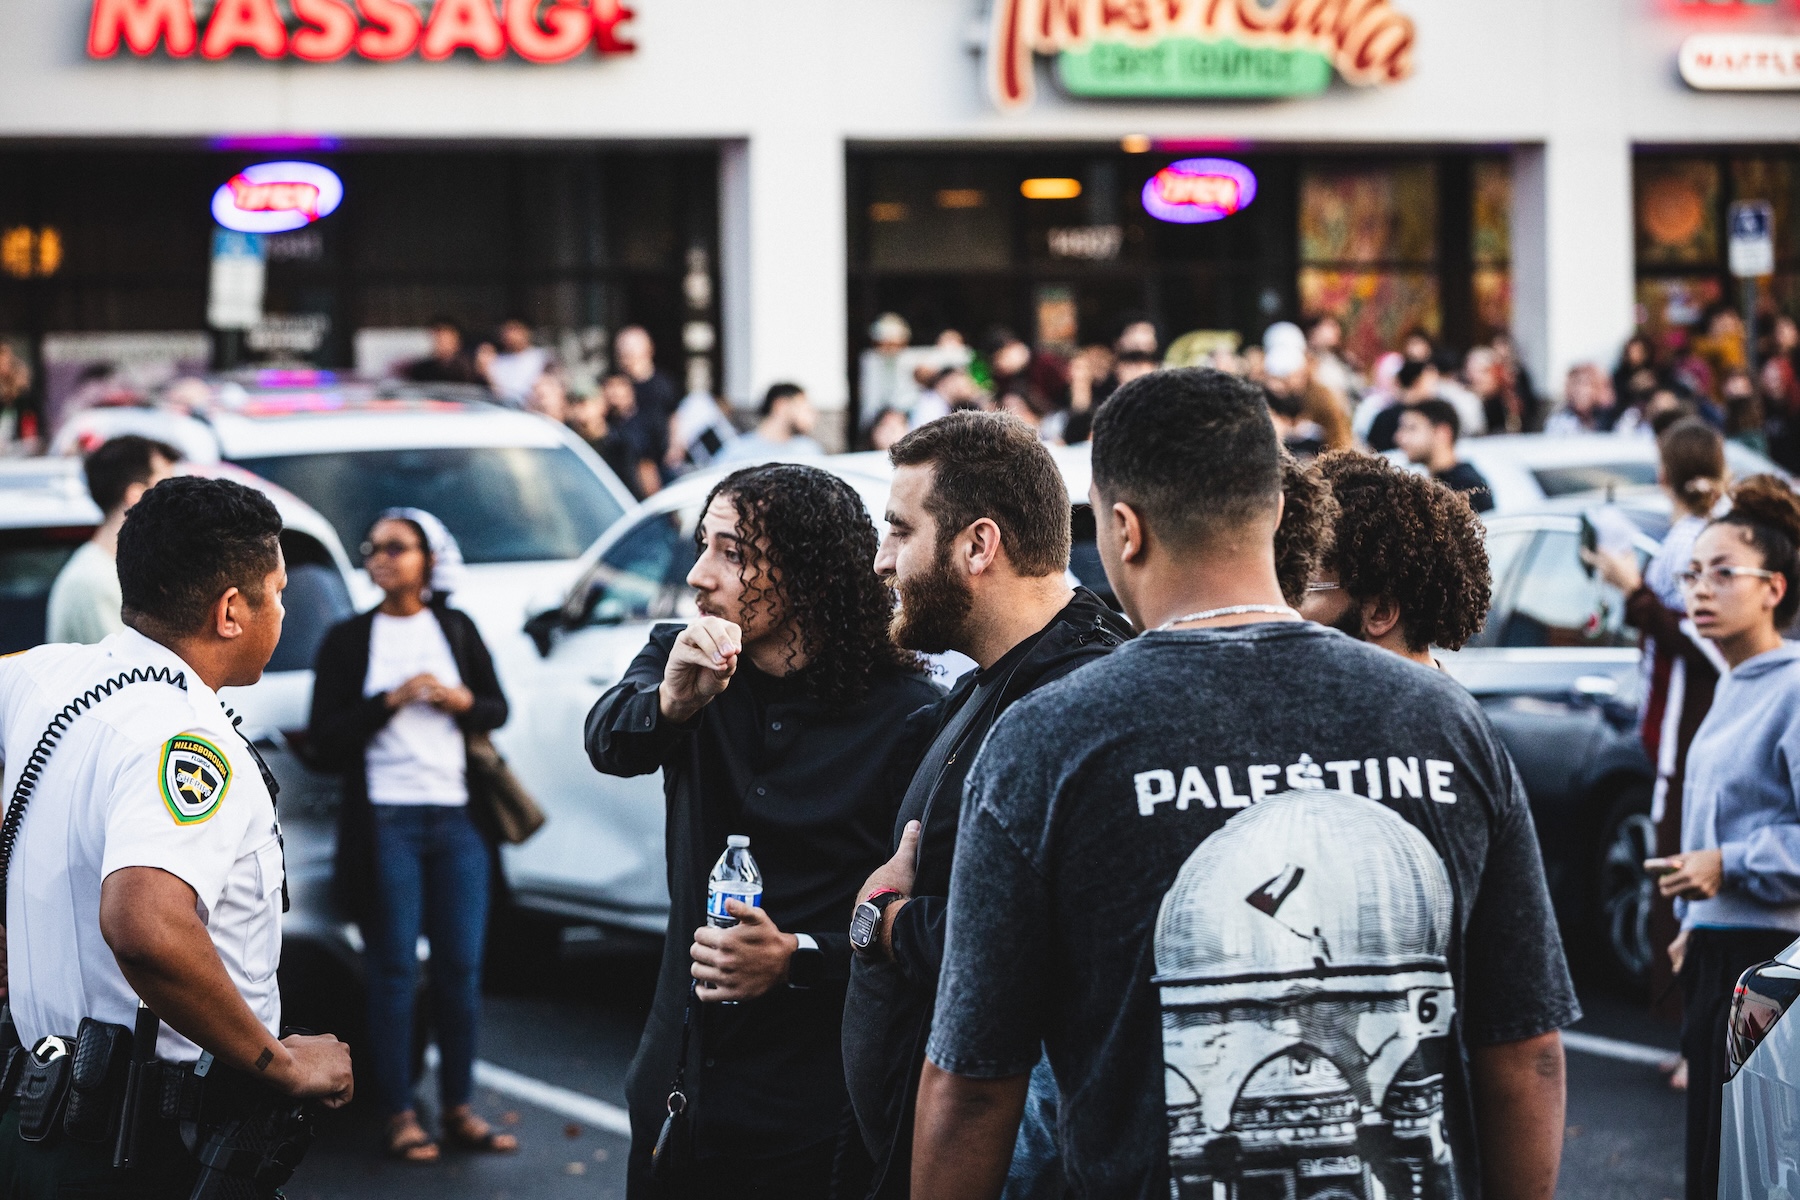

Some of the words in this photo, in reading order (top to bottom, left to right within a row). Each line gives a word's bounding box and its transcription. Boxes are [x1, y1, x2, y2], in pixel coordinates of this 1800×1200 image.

[86, 0, 636, 62] MASSAGE
[174, 741, 227, 778] HILLSBOROUGH
[190, 754, 211, 770] FLORIDA
[176, 771, 212, 798] SHERIFF
[1134, 756, 1457, 816] PALESTINE
